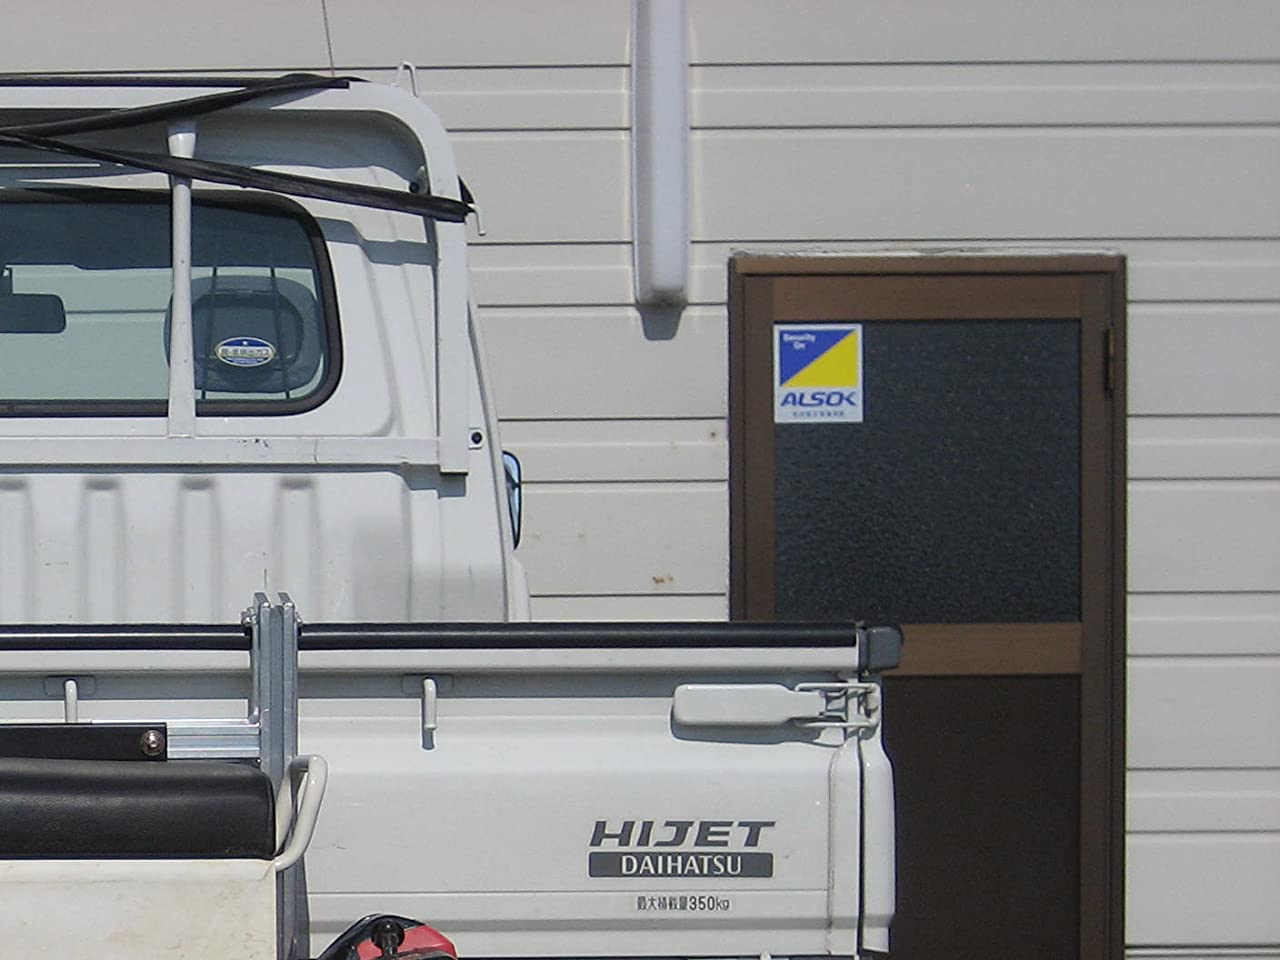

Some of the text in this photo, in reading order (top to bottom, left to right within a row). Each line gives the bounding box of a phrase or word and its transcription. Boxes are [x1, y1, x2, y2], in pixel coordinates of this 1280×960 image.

[781, 391, 857, 407] ALSOK
[589, 820, 776, 848] HIJET
[622, 855, 742, 875] DAIHATSU
